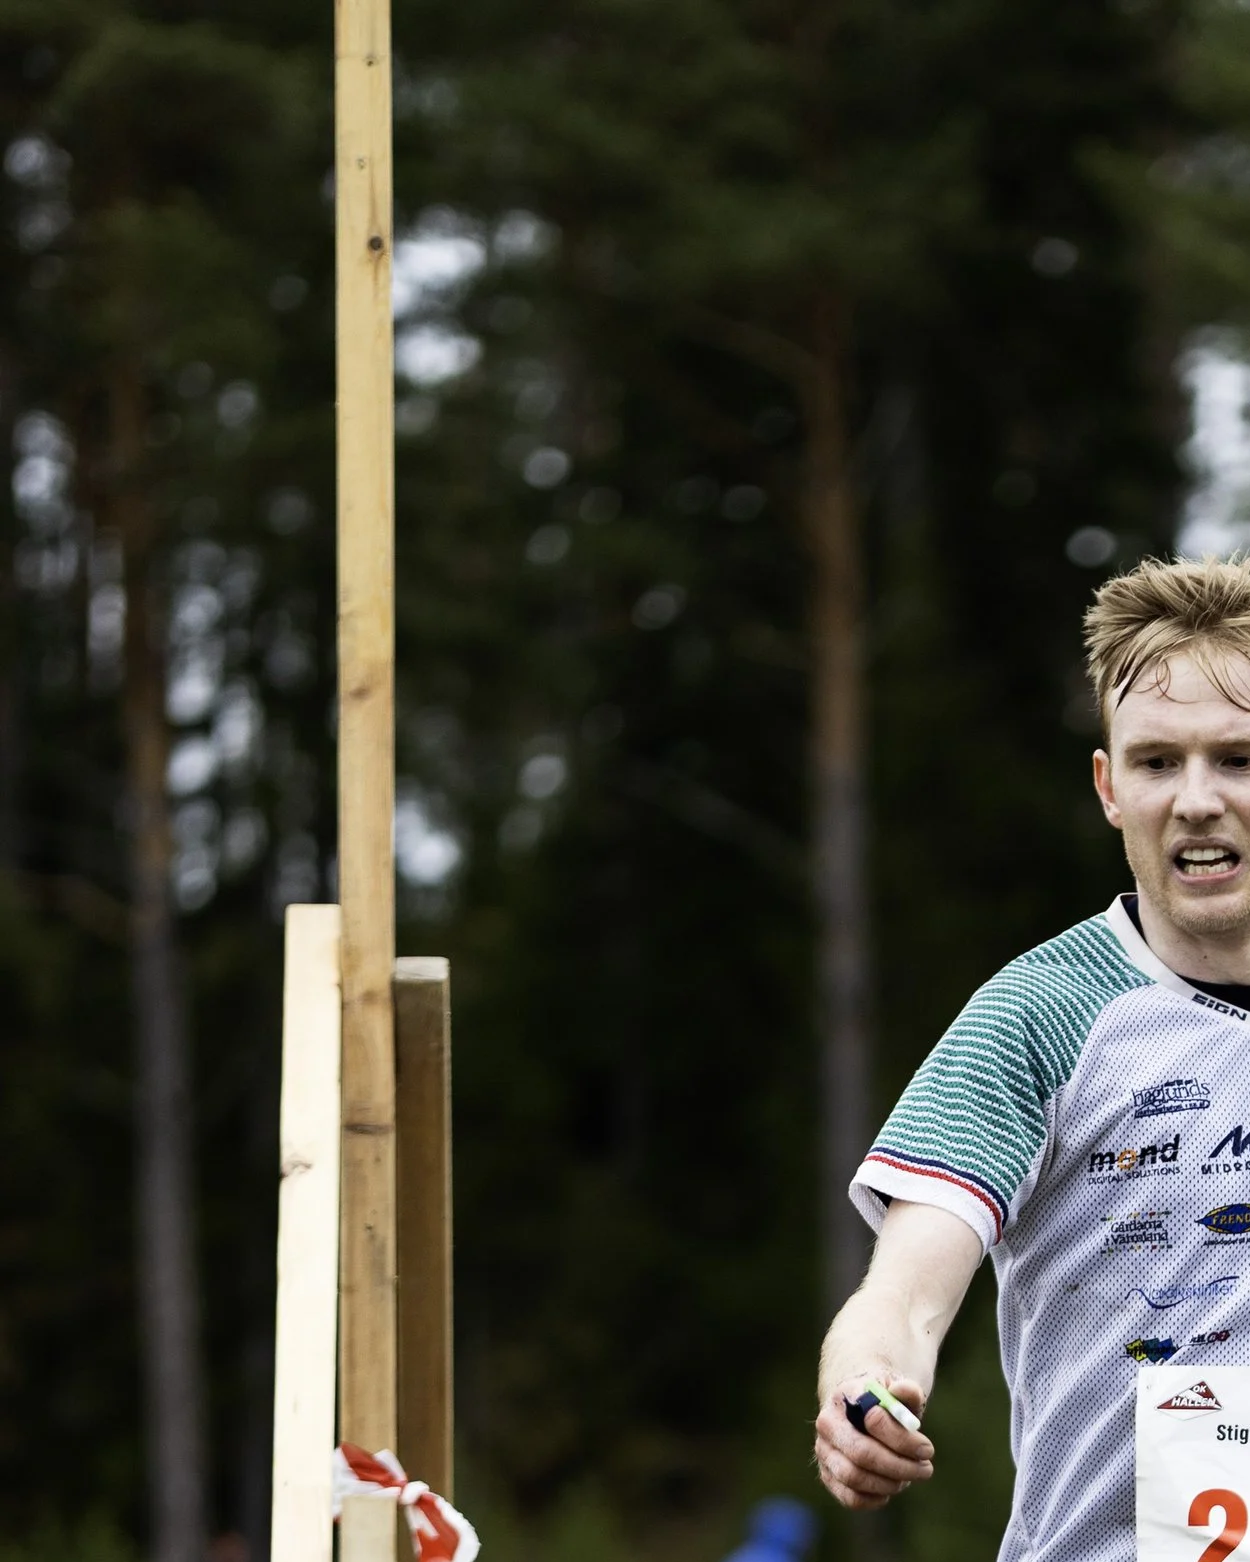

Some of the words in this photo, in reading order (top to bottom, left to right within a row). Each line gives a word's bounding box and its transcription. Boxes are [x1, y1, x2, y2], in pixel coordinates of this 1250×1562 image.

[1088, 1171, 1123, 1185] DIGITAL
[1126, 1166, 1180, 1180] SOLUTIONS
[1193, 1385, 1207, 1393] OK
